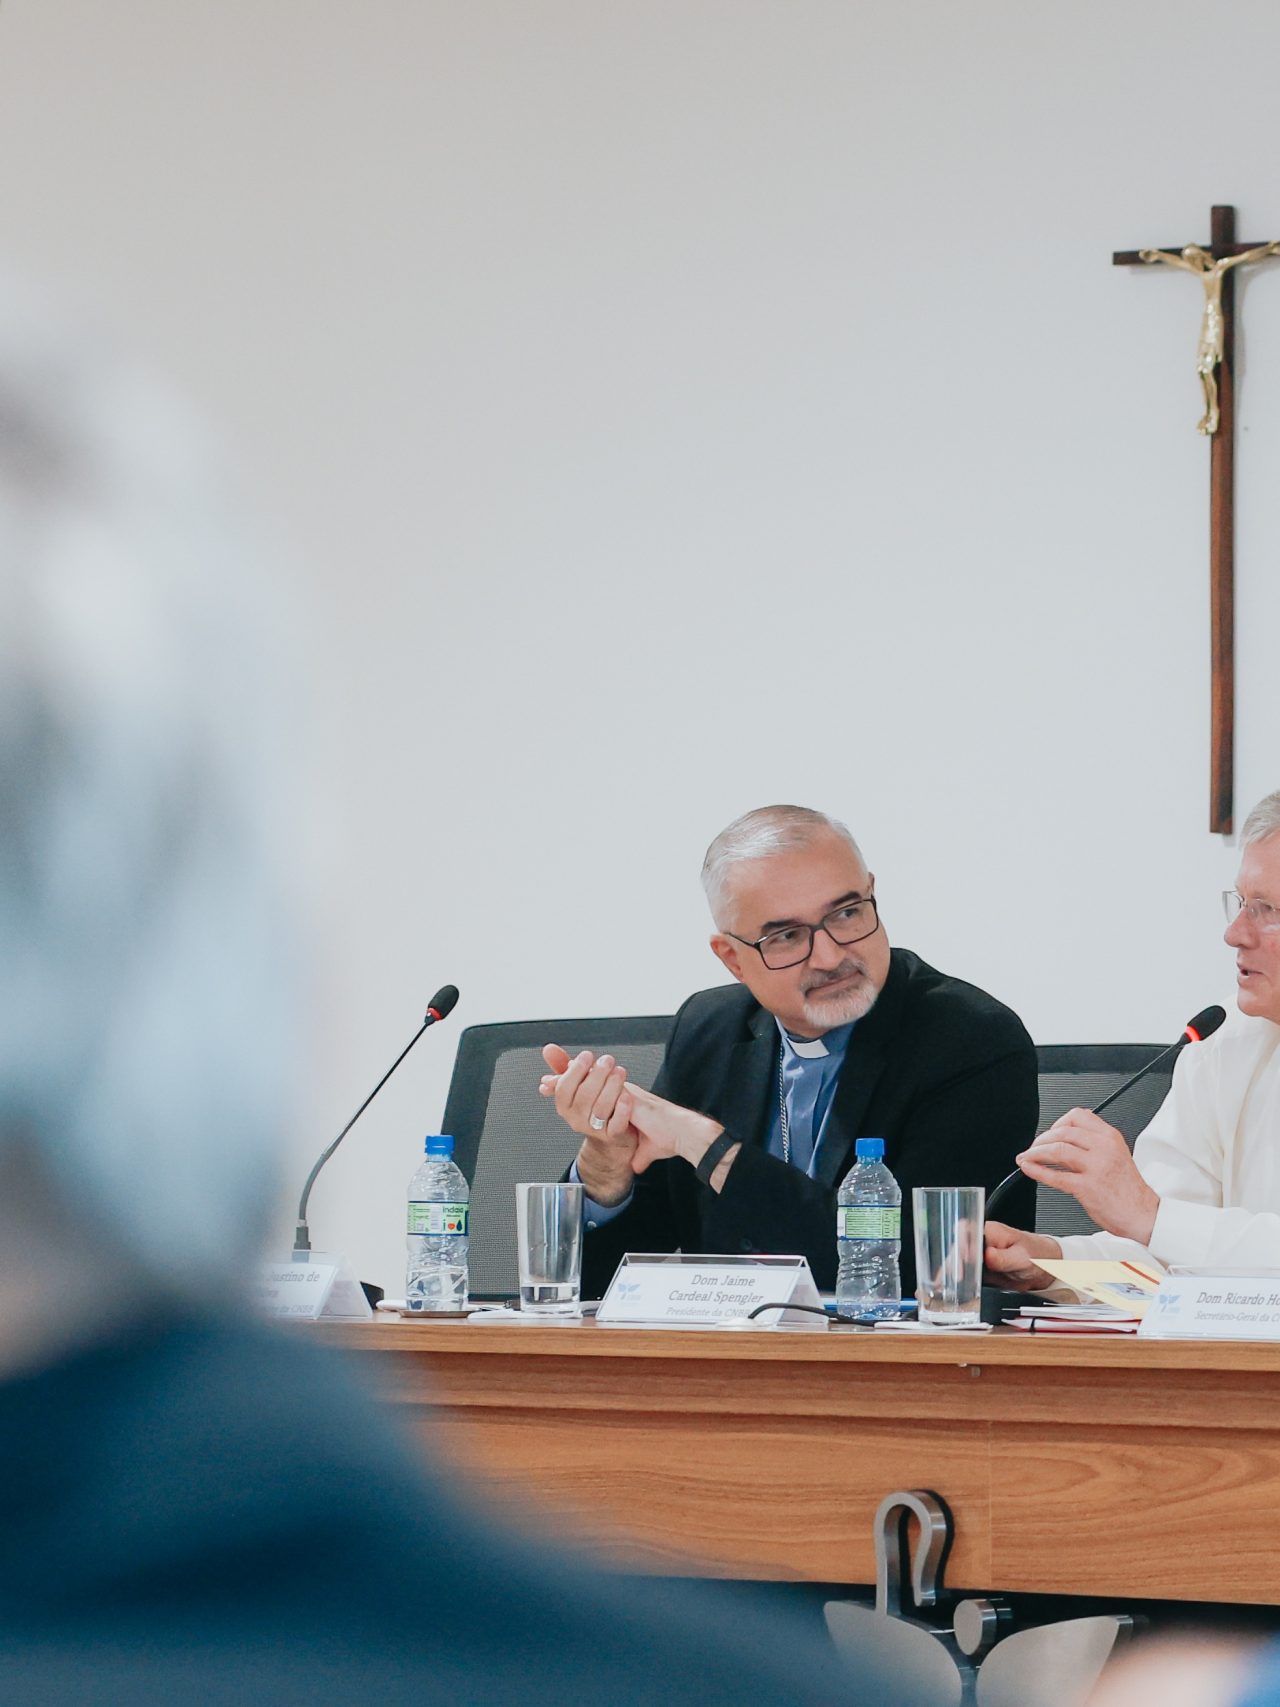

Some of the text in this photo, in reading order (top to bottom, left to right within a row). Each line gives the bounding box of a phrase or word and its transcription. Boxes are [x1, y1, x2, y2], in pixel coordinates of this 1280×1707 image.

[306, 1271, 320, 1282] de
[690, 1274, 756, 1287] Dom Jaime
[668, 1290, 764, 1306] Cardeal Spengler
[1196, 1291, 1222, 1305] Dom
[1223, 1292, 1265, 1306] Ricardo
[665, 1306, 711, 1317] Presidente
[711, 1307, 722, 1317] da
[1259, 1312, 1271, 1322] da
